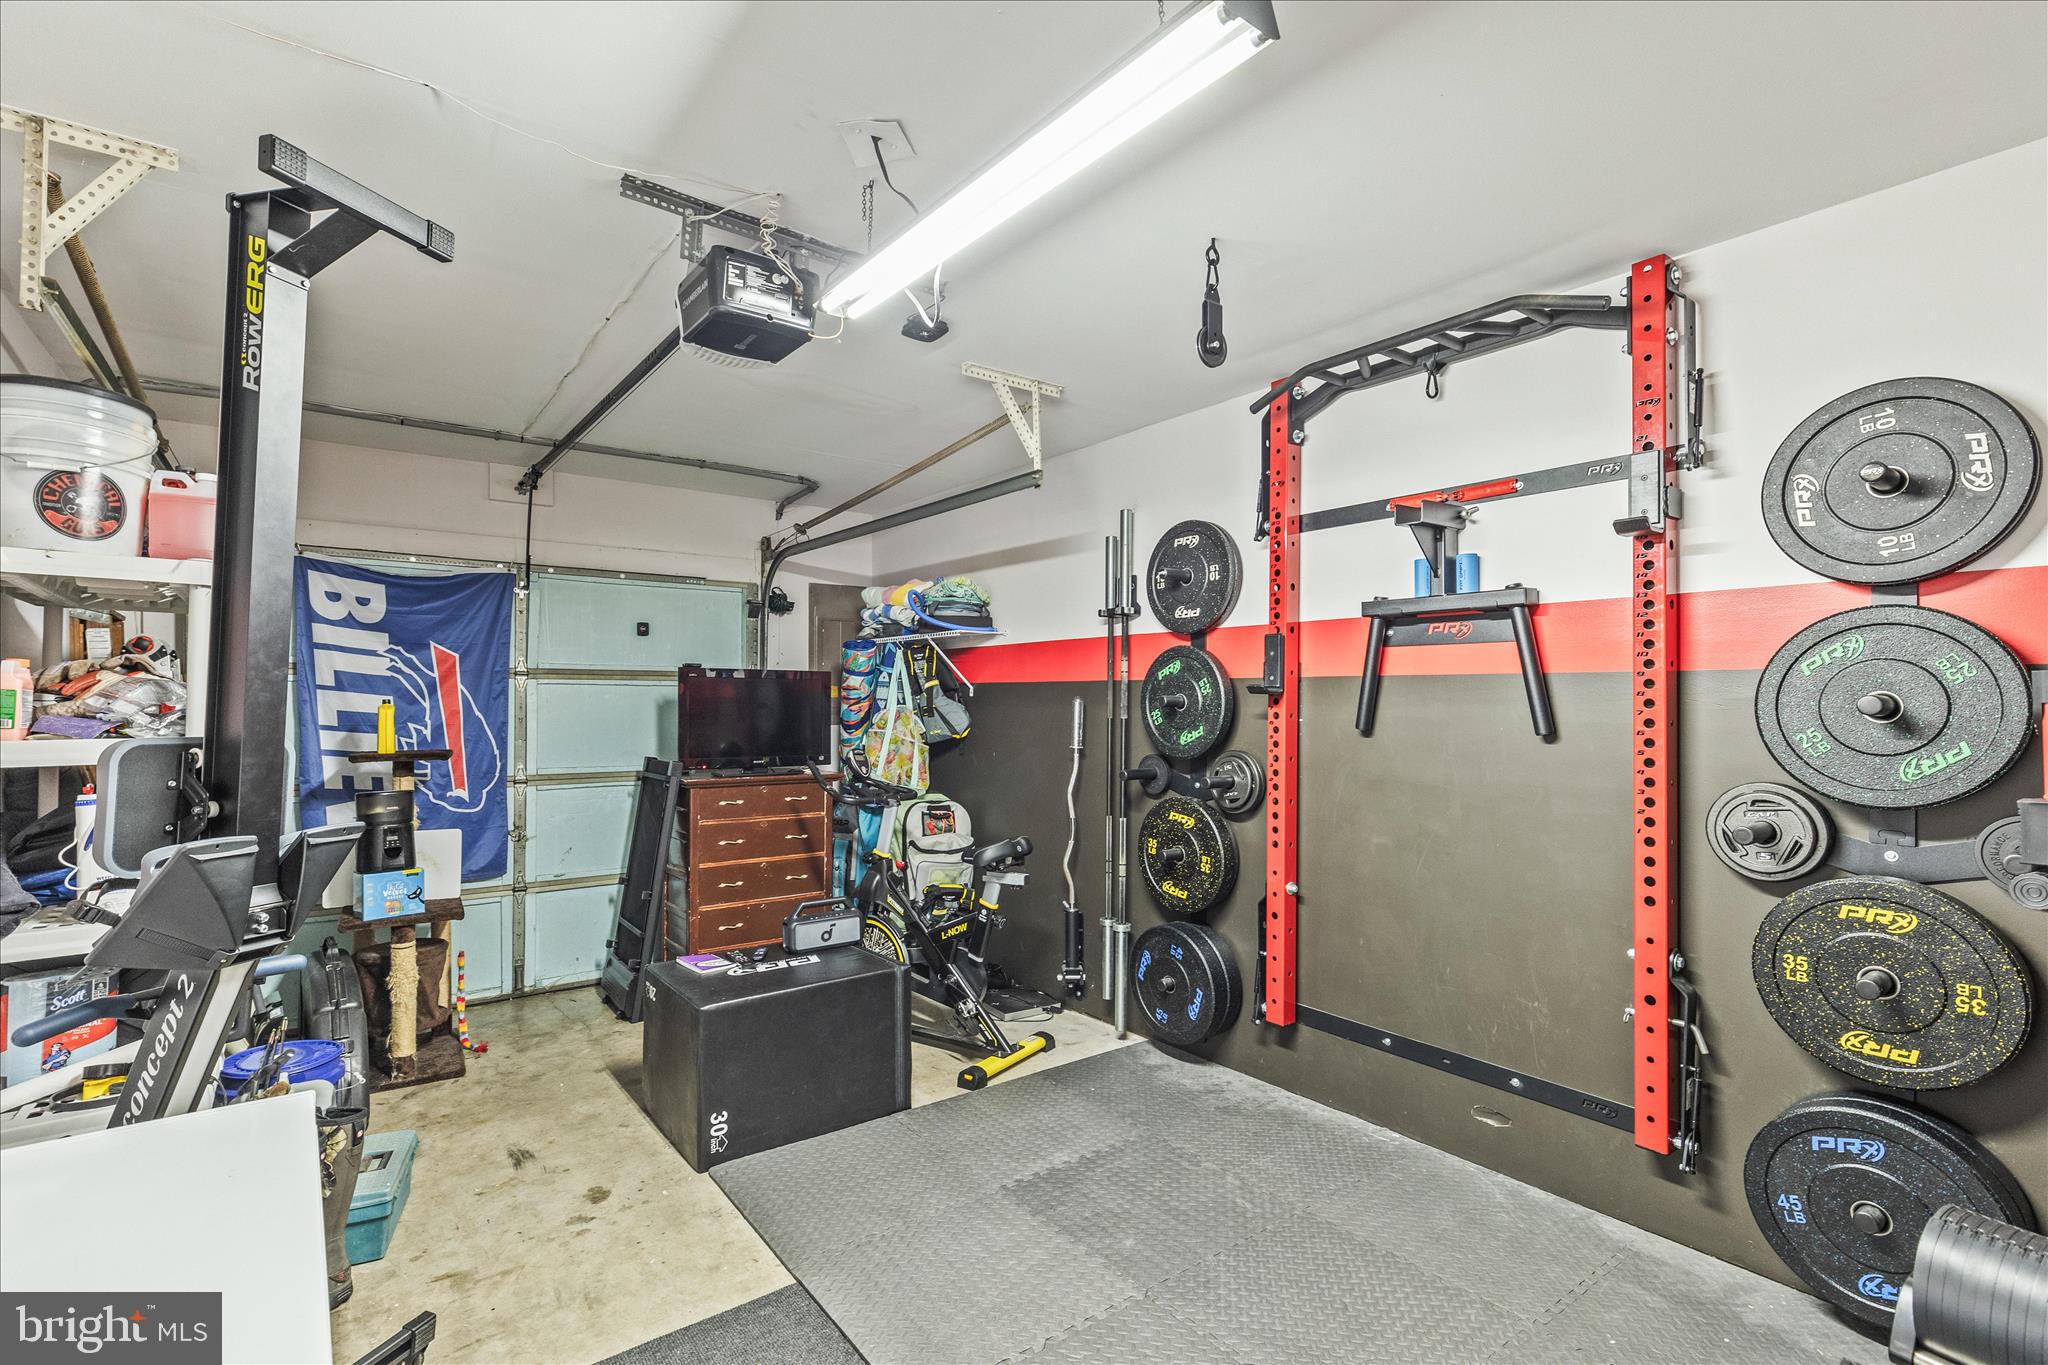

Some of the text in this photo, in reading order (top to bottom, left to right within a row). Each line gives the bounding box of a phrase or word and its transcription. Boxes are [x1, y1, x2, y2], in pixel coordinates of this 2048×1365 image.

[1858, 415, 1877, 434] LB
[1875, 407, 1896, 430] 10
[61, 518, 105, 535] GUS
[1877, 535, 1900, 557] 10
[1899, 532, 1916, 551] LB
[1988, 832, 2015, 881] ERFORMANCE
[941, 922, 968, 940] L-NOW
[1782, 954, 1809, 972] 35
[1786, 969, 1809, 983] LB
[178, 973, 195, 999] 2
[1956, 983, 1983, 999] LB
[50, 988, 88, 1011] Scott
[1955, 997, 1987, 1017] 35
[710, 1110, 728, 1137] 30
[1811, 1135, 1885, 1163] PRX
[1777, 1194, 1803, 1212] 45
[1784, 1210, 1807, 1224] LB
[1858, 1273, 1900, 1300] RX
